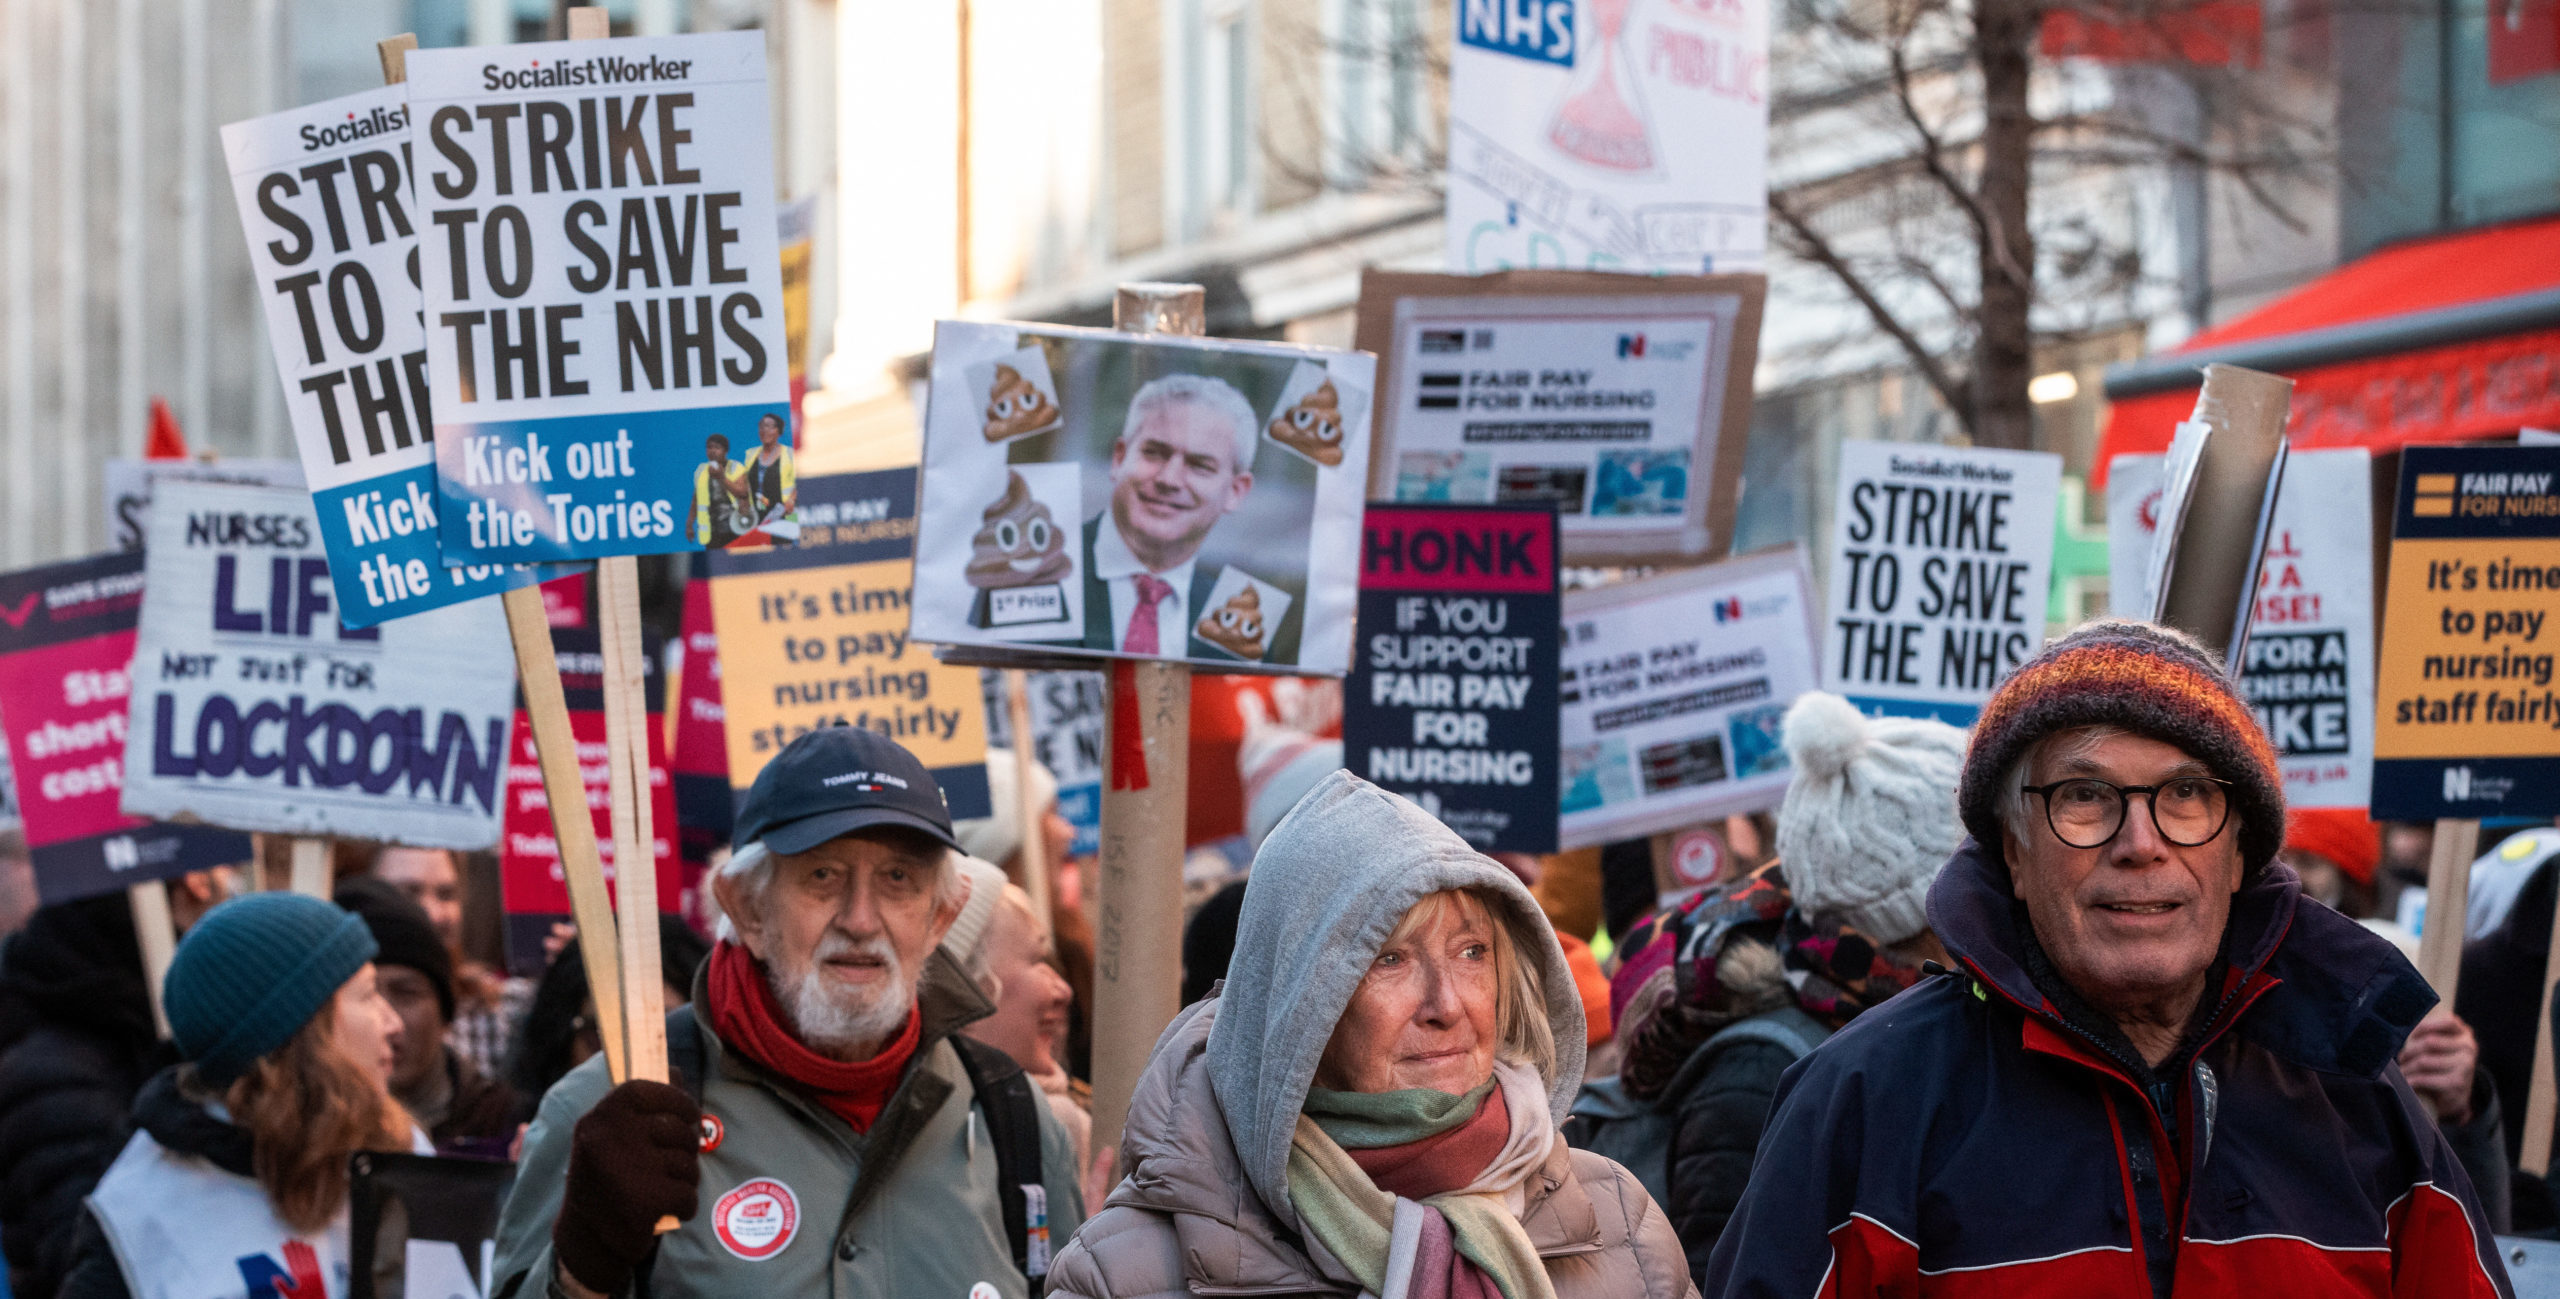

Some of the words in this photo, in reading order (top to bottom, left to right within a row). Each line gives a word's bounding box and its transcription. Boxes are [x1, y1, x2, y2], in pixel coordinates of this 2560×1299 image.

[1465, 0, 1573, 58] NHS
[430, 92, 701, 200] STRIKE
[432, 203, 534, 300] TO
[564, 192, 748, 294] SAVE
[275, 260, 386, 367] TO
[441, 304, 590, 403] THE
[616, 292, 767, 392] NHS
[1469, 370, 1530, 387] FAIR
[1539, 369, 1593, 386] PAY
[1466, 392, 1522, 409] FOR
[1531, 390, 1656, 410] NURSING
[464, 432, 553, 486] Kick
[566, 429, 635, 479] out
[2461, 473, 2508, 494] FAIR
[2511, 472, 2552, 494] PAY
[343, 482, 439, 547] Kick
[467, 499, 535, 549] the
[547, 493, 674, 544] Tories
[840, 497, 891, 524] PAY
[1848, 482, 2013, 553] STRIKE
[2460, 496, 2502, 517] FOR
[187, 513, 310, 549] NURSES
[1365, 529, 1537, 576] HONK
[360, 554, 431, 607] the
[1845, 551, 1899, 614] TO
[1919, 556, 2030, 625] SAVE
[2428, 560, 2482, 591] It's
[2487, 557, 2560, 591] time
[760, 591, 820, 622] It's
[1018, 592, 1057, 608] Prize
[1396, 598, 1427, 631] IF
[1434, 598, 1507, 633] YOU
[2441, 608, 2476, 635] to
[2483, 610, 2545, 641] pay
[785, 636, 826, 662] to
[837, 629, 908, 666] pay
[1371, 635, 1533, 672] SUPPORT
[1647, 646, 1767, 685] NURSING
[1648, 639, 1699, 664] PAY
[1837, 620, 1924, 685] THE
[2246, 637, 2315, 670] FOR
[2319, 635, 2345, 666] A
[2423, 645, 2554, 685] nursing
[162, 652, 217, 681] NOT
[774, 666, 929, 706] nursing
[1371, 674, 1456, 706] FAIR
[1461, 676, 1532, 709] PAY
[2395, 691, 2477, 725] staff
[1413, 713, 1488, 746] FOR
[153, 693, 505, 819] LOCKDOWN
[1370, 750, 1533, 785] NURSING
[822, 771, 868, 787] TOMMY
[872, 771, 908, 790] JEANS
